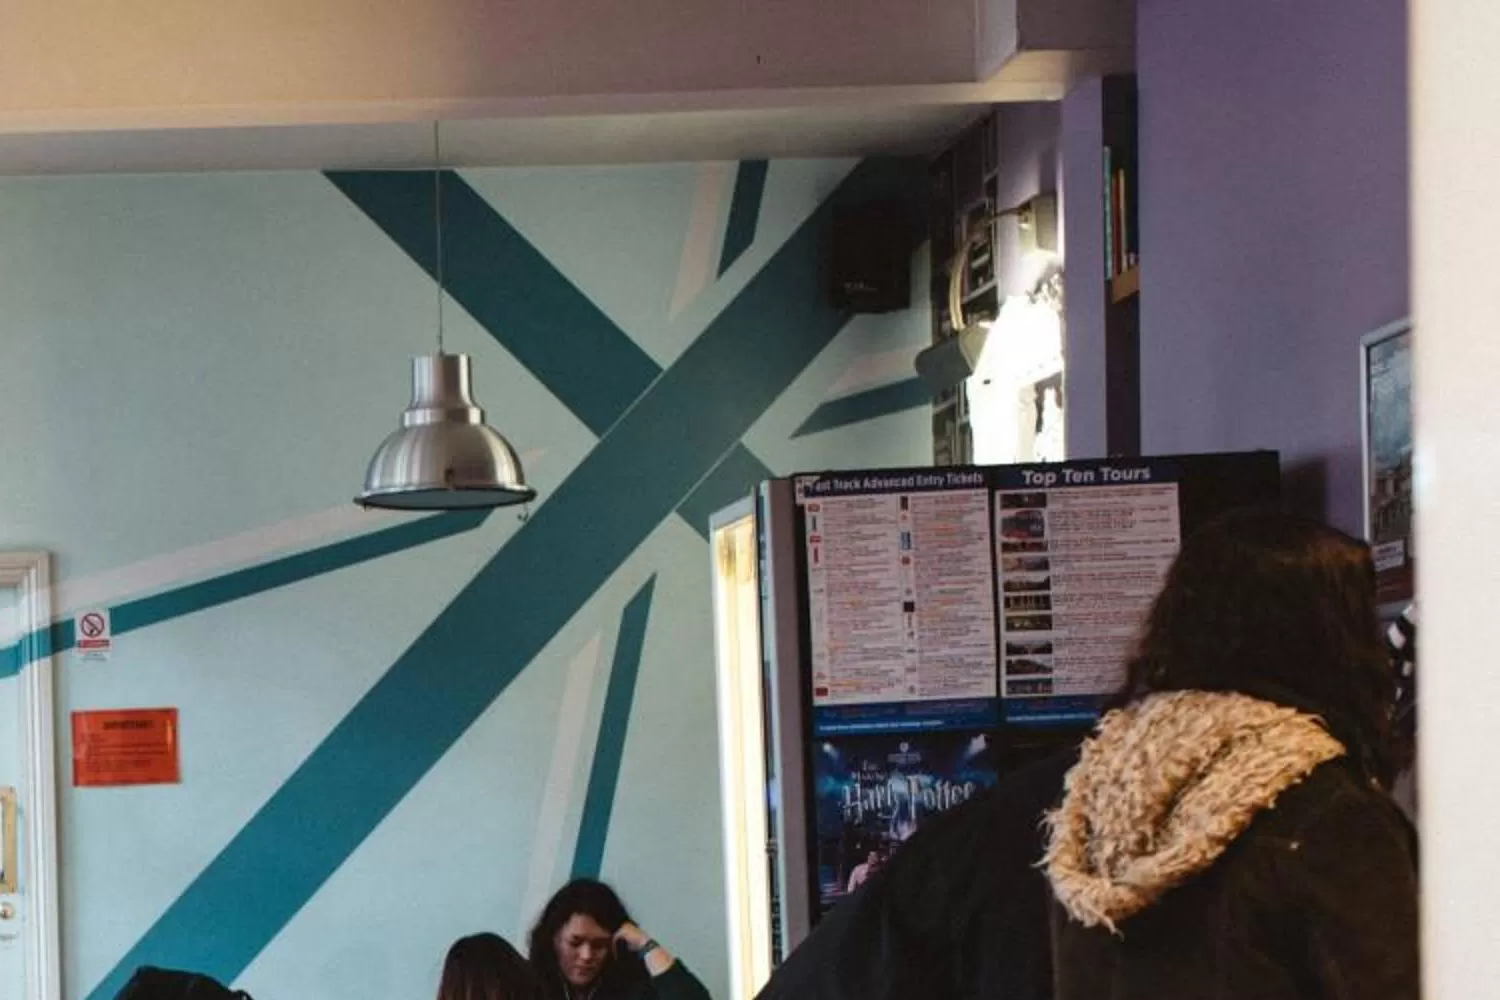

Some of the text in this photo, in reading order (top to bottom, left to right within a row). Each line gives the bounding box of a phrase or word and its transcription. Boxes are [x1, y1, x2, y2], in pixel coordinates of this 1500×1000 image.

[863, 474, 915, 489] Advanced
[916, 474, 945, 488] Entry
[946, 471, 984, 485] Tickets
[1021, 466, 1152, 487] Top Ten Tours
[905, 774, 976, 821] Potter
